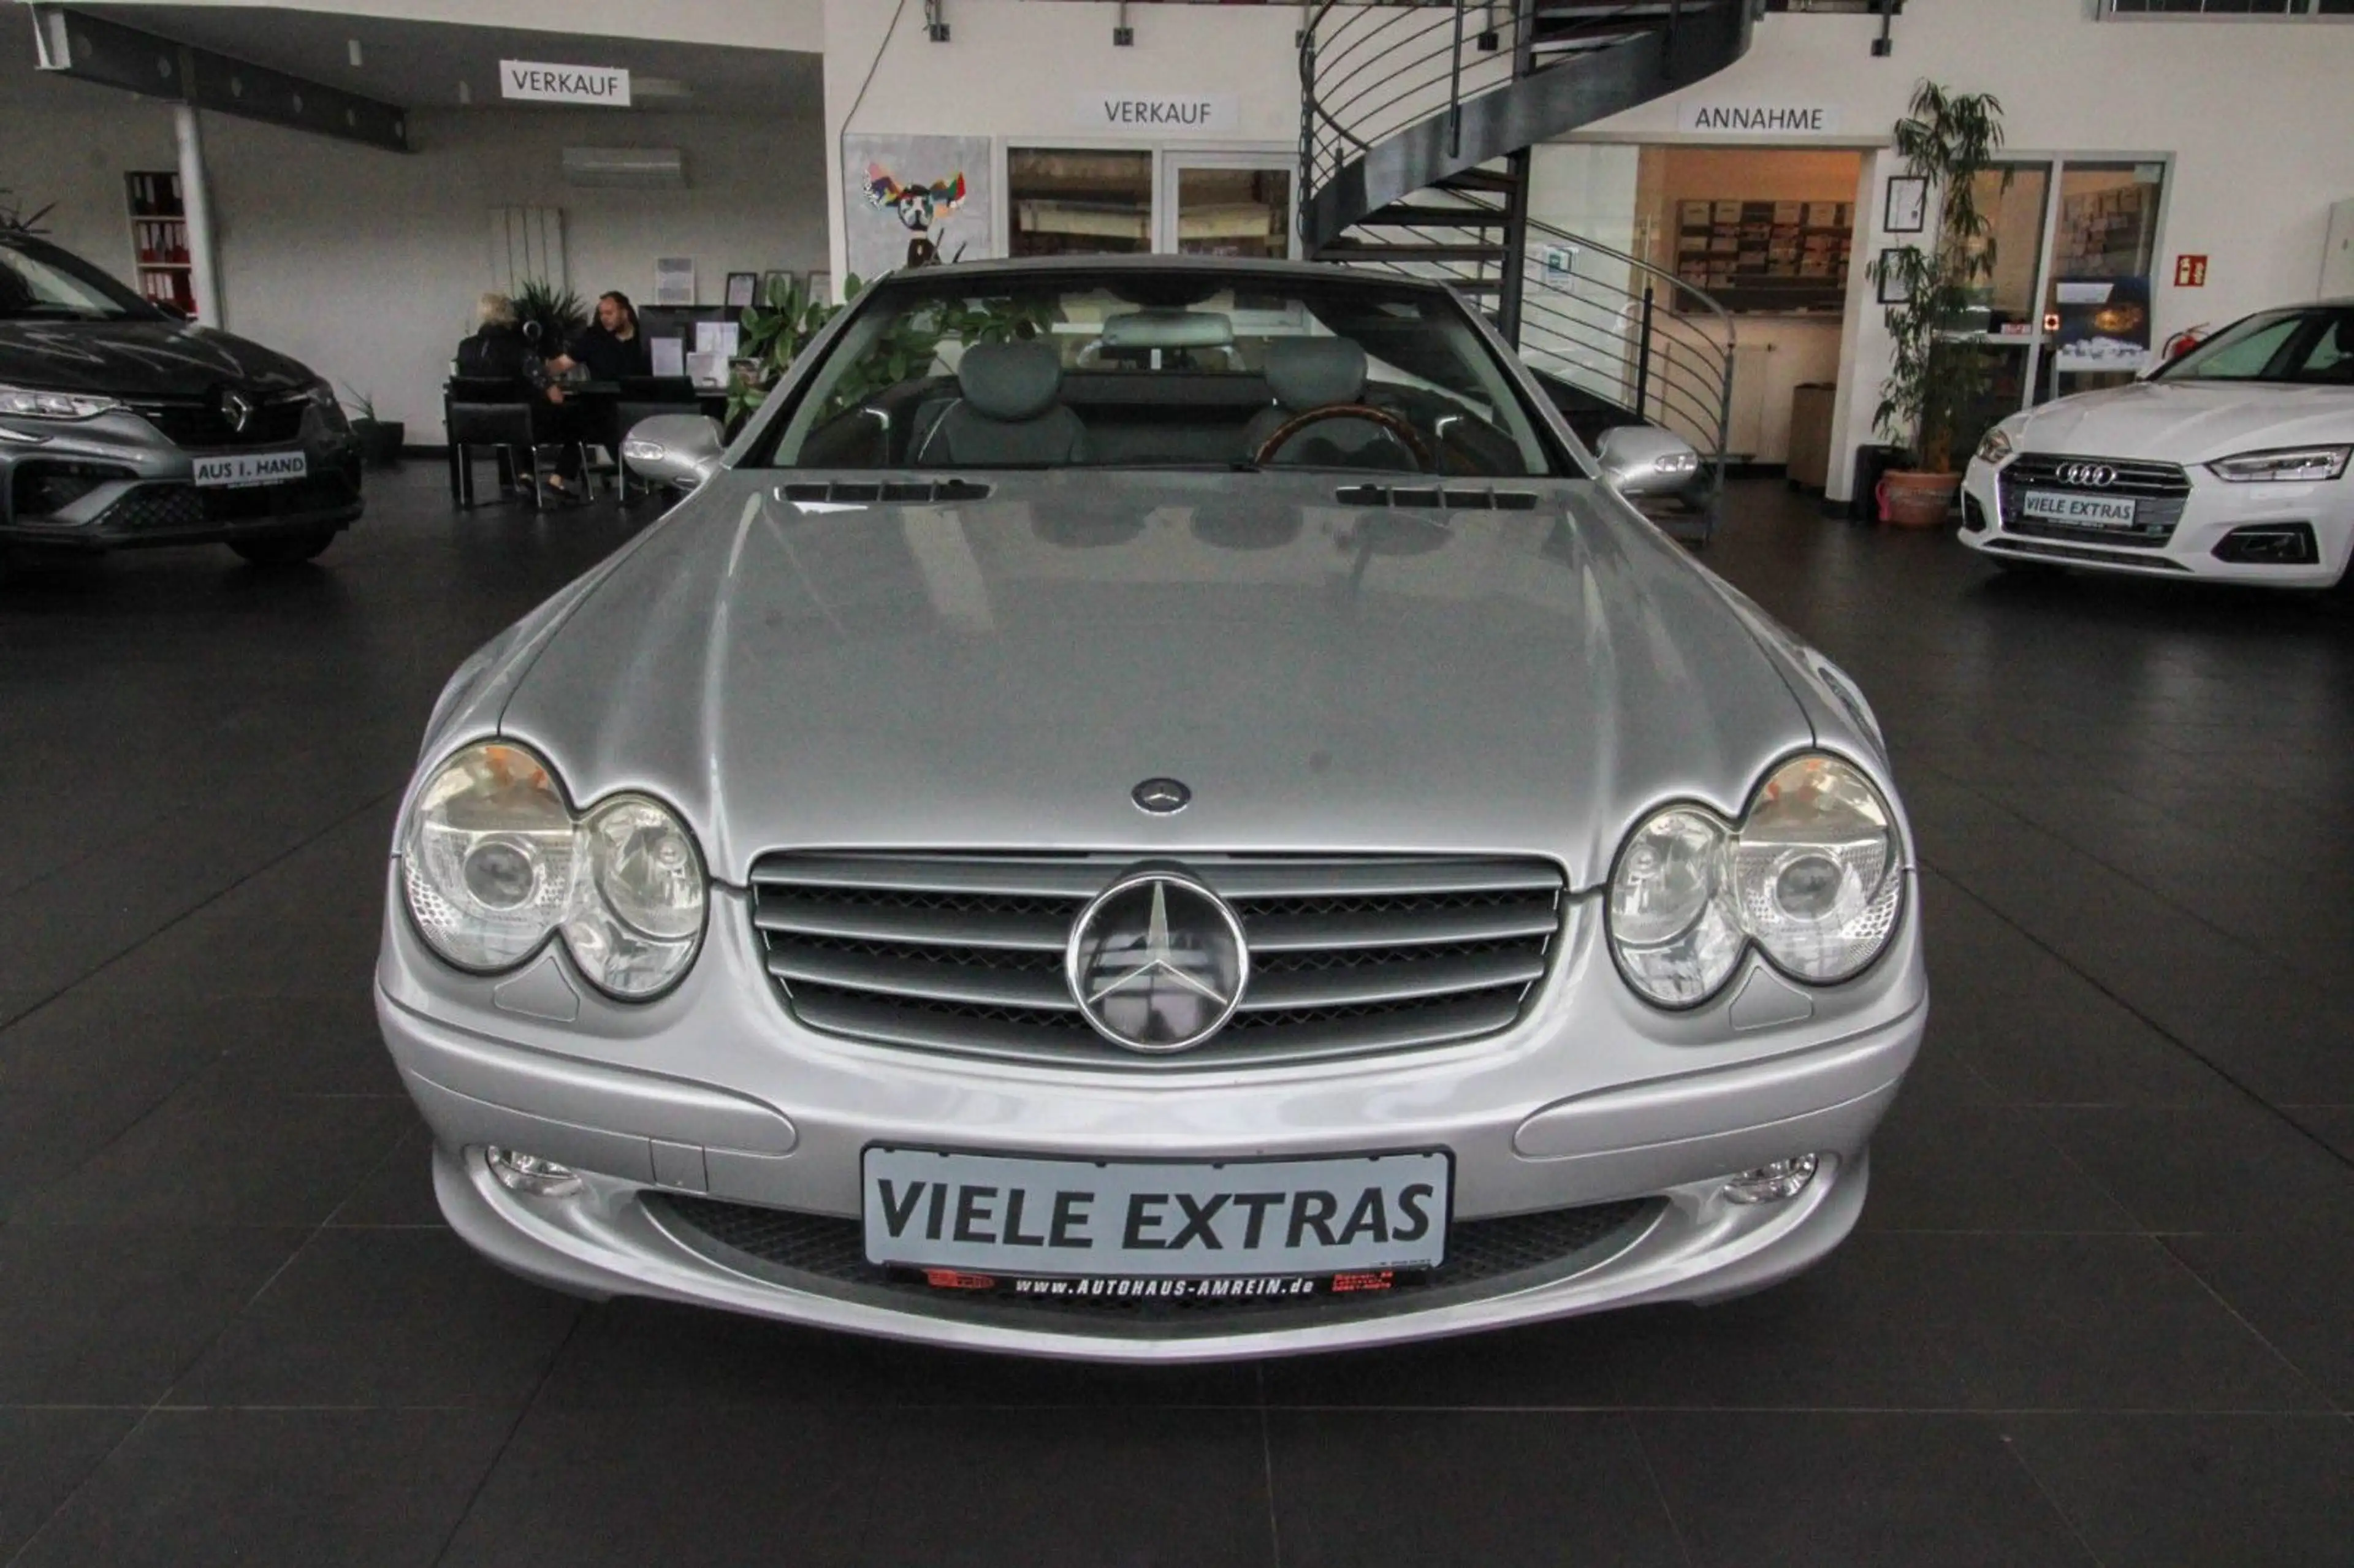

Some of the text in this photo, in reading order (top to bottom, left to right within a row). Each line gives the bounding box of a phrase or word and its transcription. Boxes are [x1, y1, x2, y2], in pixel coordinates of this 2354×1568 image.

[512, 70, 618, 96] VERKAUF
[1104, 101, 1211, 124] VERKAUF
[1694, 107, 1823, 129] ANNAHME
[198, 462, 232, 479] AUS
[256, 457, 304, 475] HAND
[2027, 497, 2131, 519] VIELE EXTRAS
[877, 1178, 1433, 1250] VIELE EXTRAS
[1016, 1277, 1314, 1296] www.AUTOHAUS-AMREIN.de
